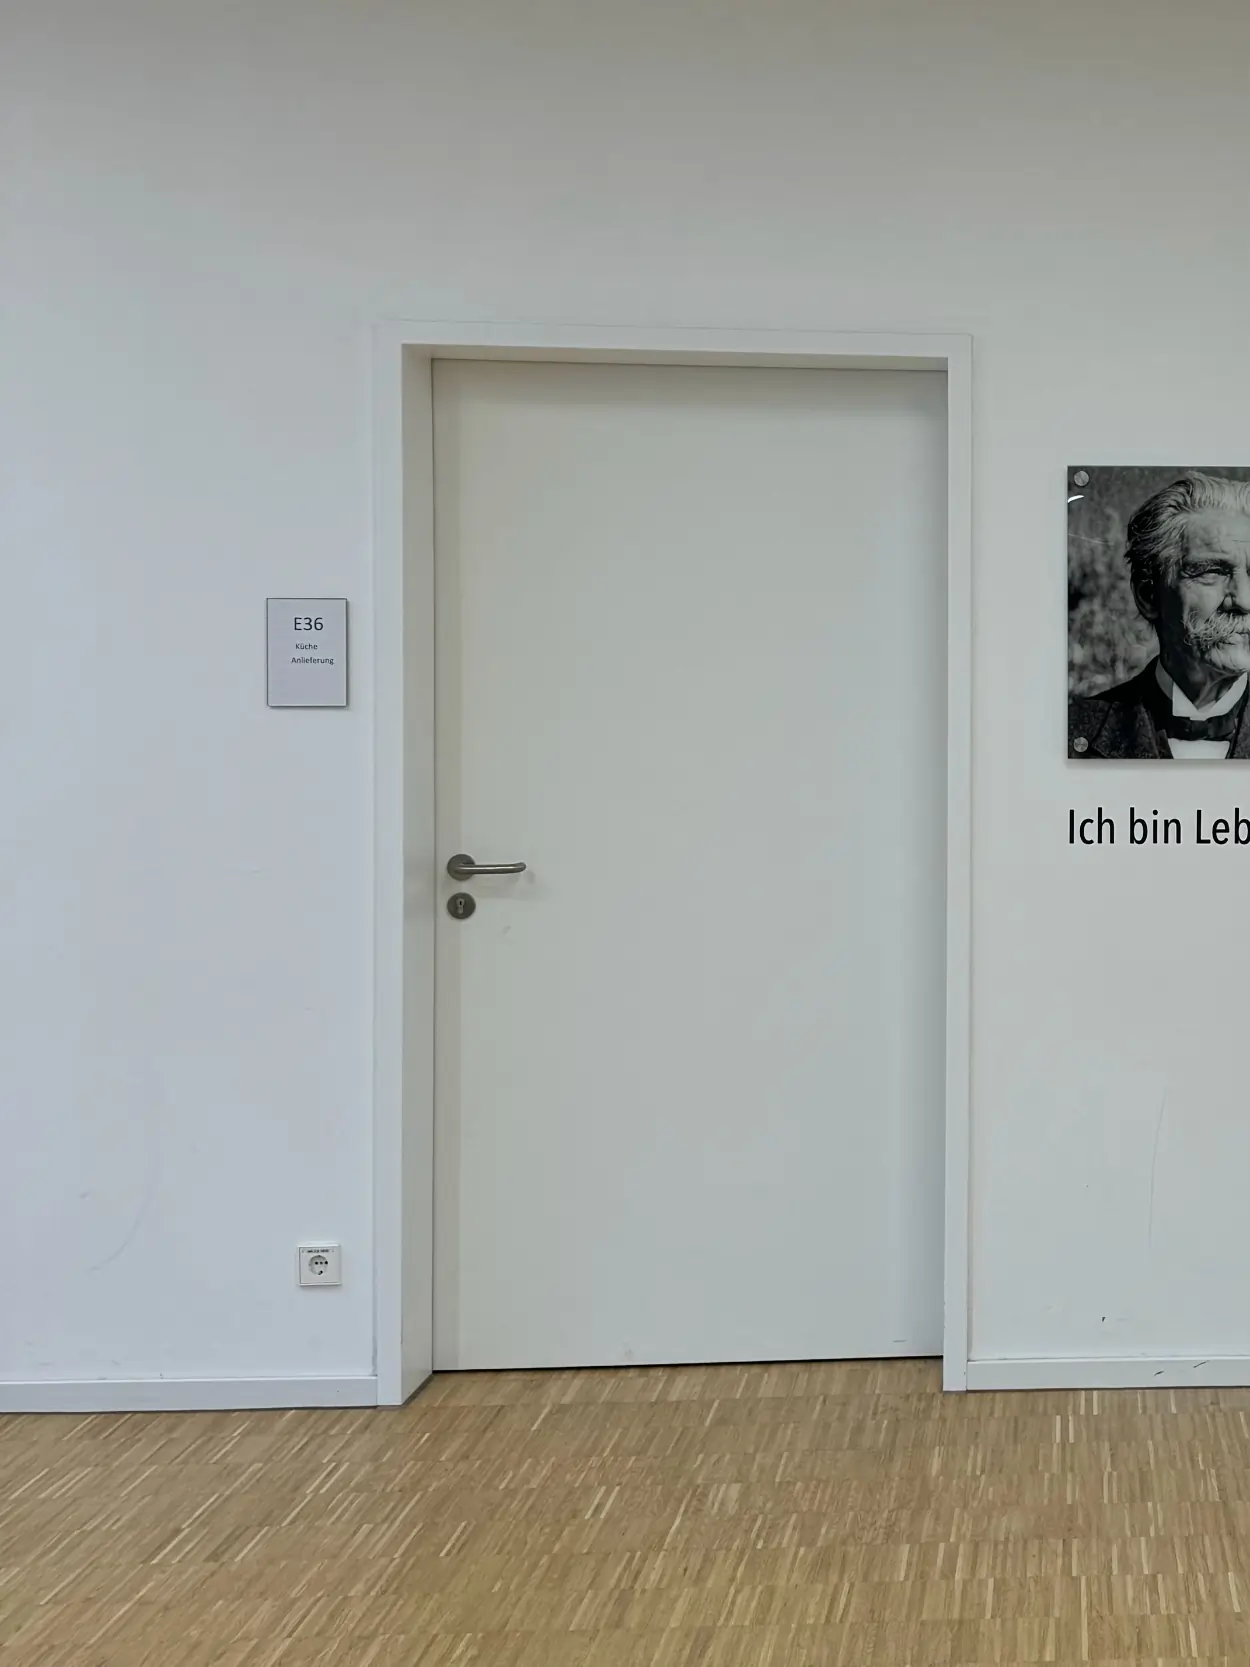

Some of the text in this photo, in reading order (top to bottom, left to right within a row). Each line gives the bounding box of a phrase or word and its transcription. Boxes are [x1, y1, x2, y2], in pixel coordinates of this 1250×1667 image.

[294, 616, 324, 631] E36
[295, 642, 318, 650] Küche
[290, 656, 334, 666] Anlieferung
[1069, 807, 1115, 845] Ich
[1129, 807, 1182, 845] bin
